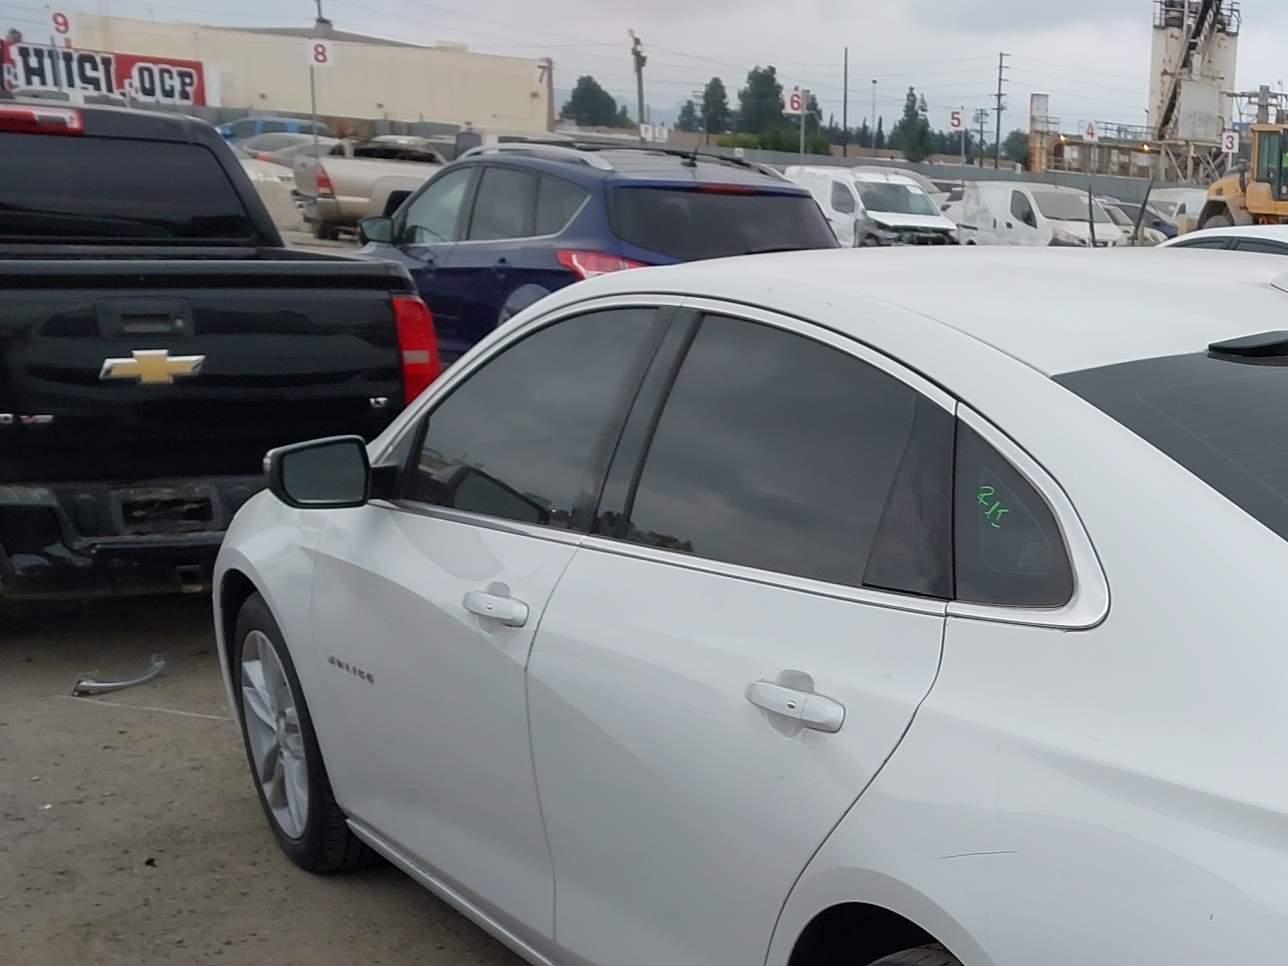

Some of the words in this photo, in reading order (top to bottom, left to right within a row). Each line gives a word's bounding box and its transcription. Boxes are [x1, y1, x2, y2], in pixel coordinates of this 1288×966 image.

[52, 12, 69, 34] 9
[313, 43, 327, 64] 8
[537, 64, 548, 84] 7
[790, 94, 801, 111] 6
[950, 111, 961, 128] 5
[1085, 122, 1095, 138] 4
[1225, 135, 1235, 151] 3
